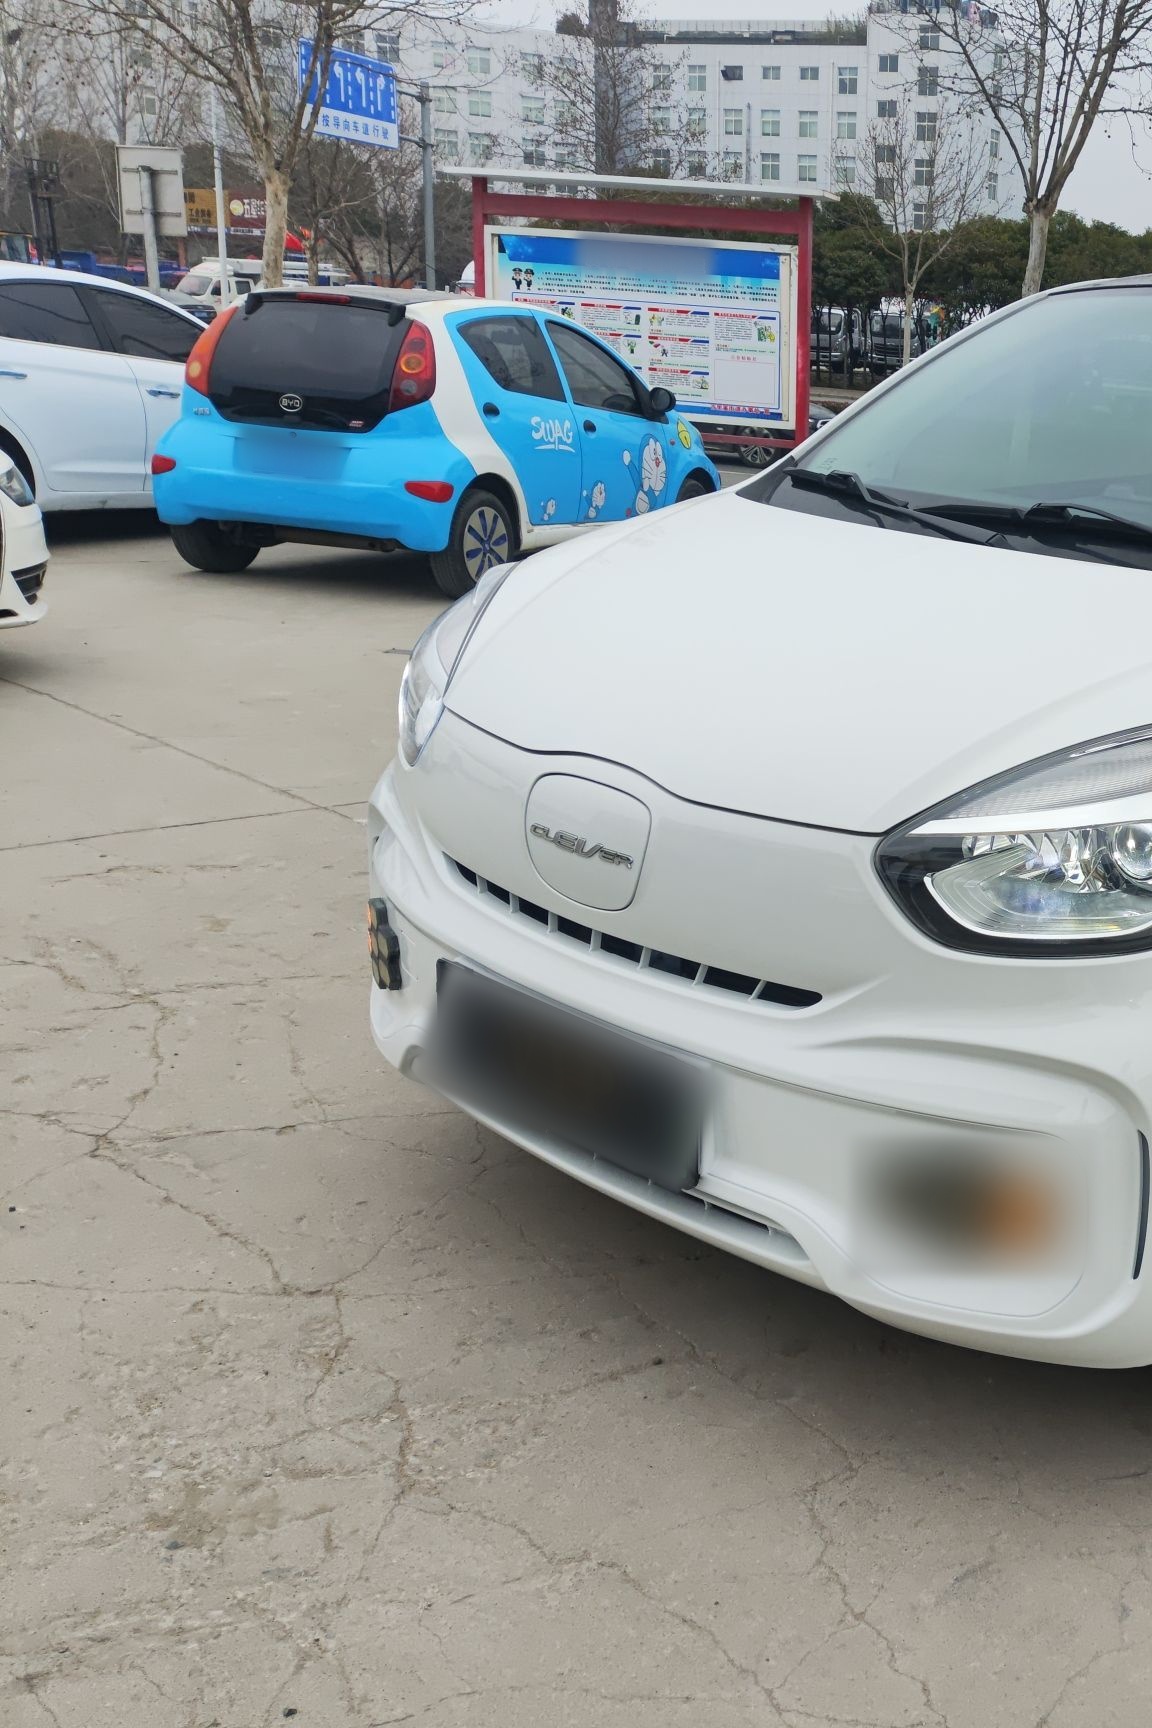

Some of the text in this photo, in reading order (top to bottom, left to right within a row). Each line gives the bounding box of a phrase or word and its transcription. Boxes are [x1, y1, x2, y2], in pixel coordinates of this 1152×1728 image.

[316, 113, 389, 140] 按导向车道行驶
[531, 416, 573, 446] SWAG
[530, 822, 633, 869] CLEVER
